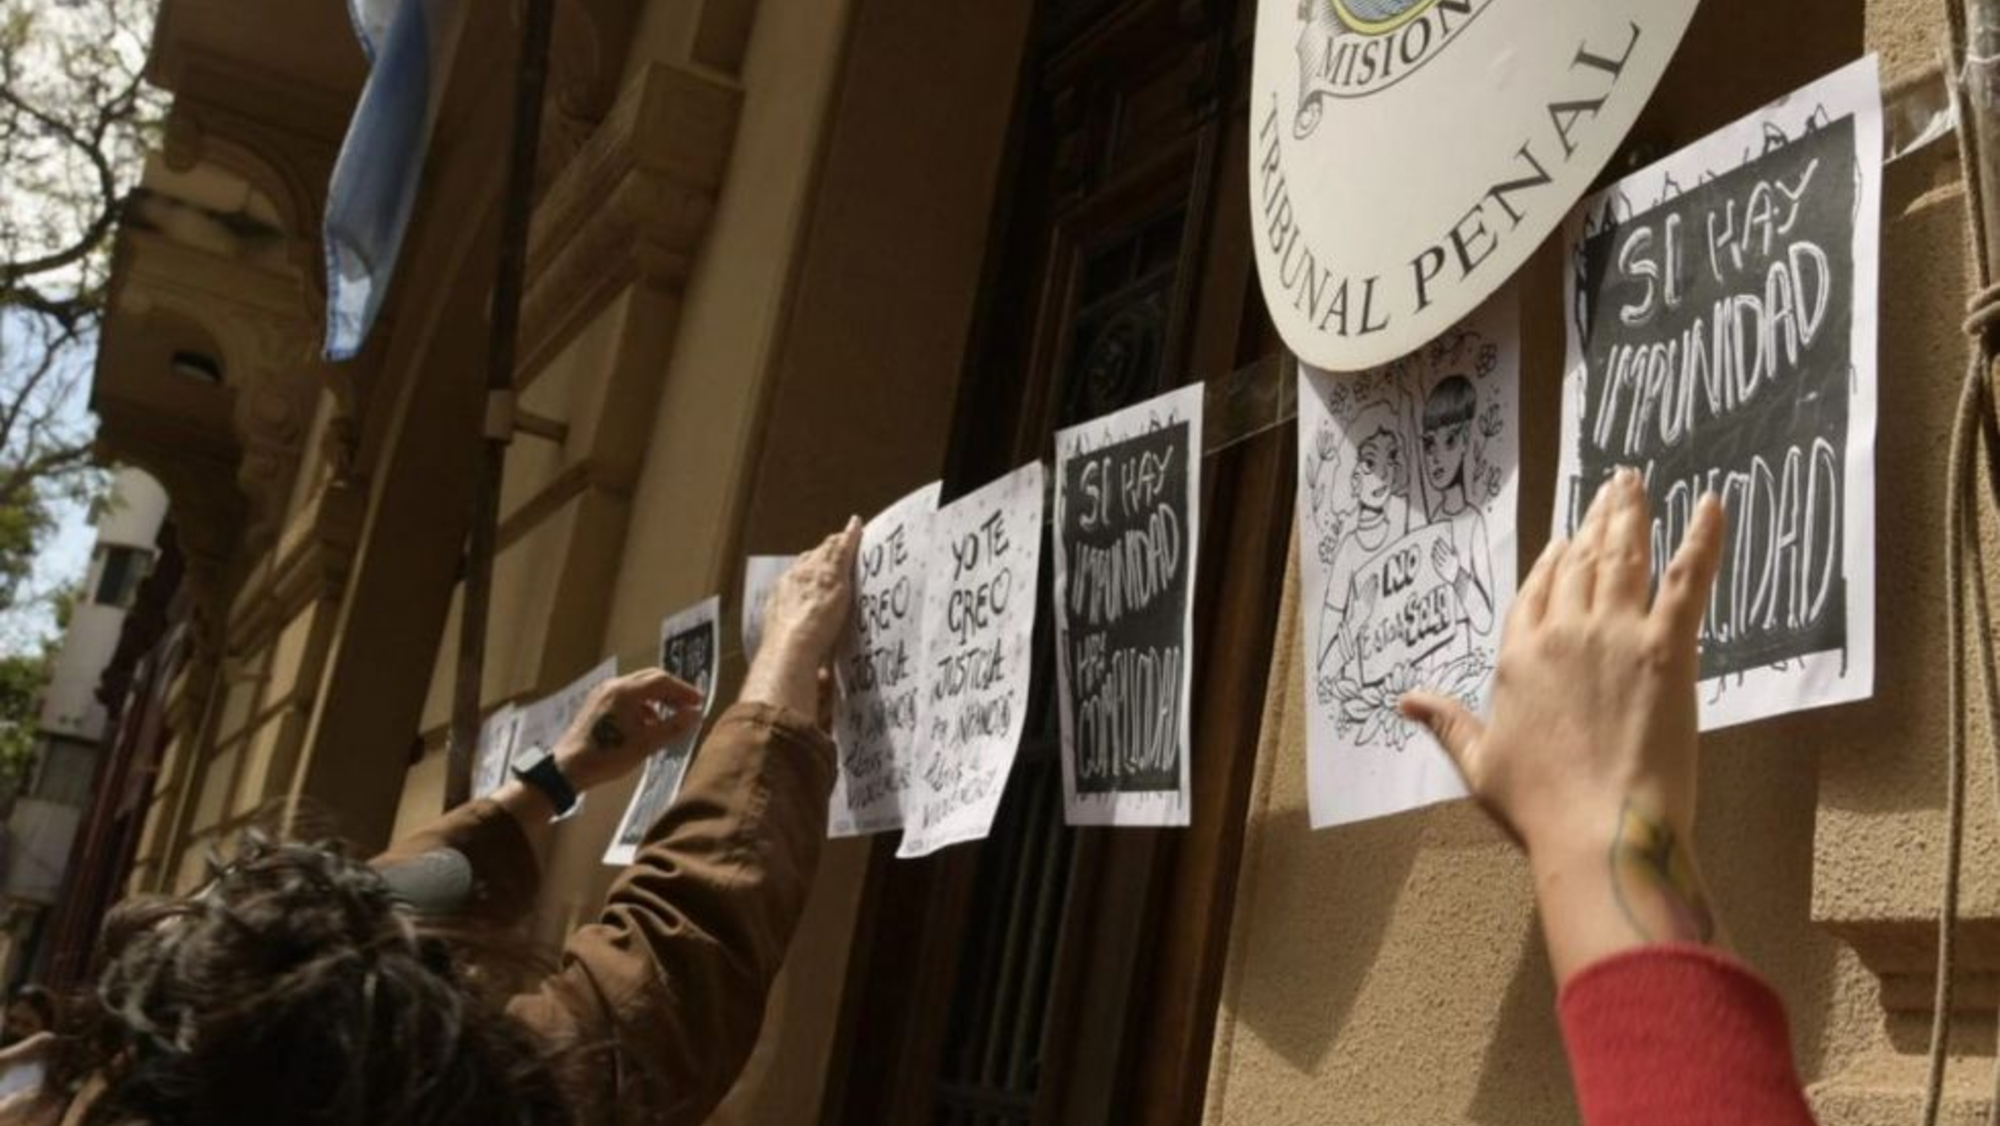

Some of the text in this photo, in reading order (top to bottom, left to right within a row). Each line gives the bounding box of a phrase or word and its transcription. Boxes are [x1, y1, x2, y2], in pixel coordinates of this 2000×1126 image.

[1259, 22, 1641, 336] TRIBUNAL PENAL
[1617, 158, 1819, 324] SI HAY
[1593, 241, 1830, 456] IMPUNIDAD
[1079, 445, 1174, 531] SI HAY
[885, 523, 908, 573] TE
[952, 509, 1010, 581] YO TE
[858, 576, 911, 645] CREO
[947, 567, 1011, 645] CREO
